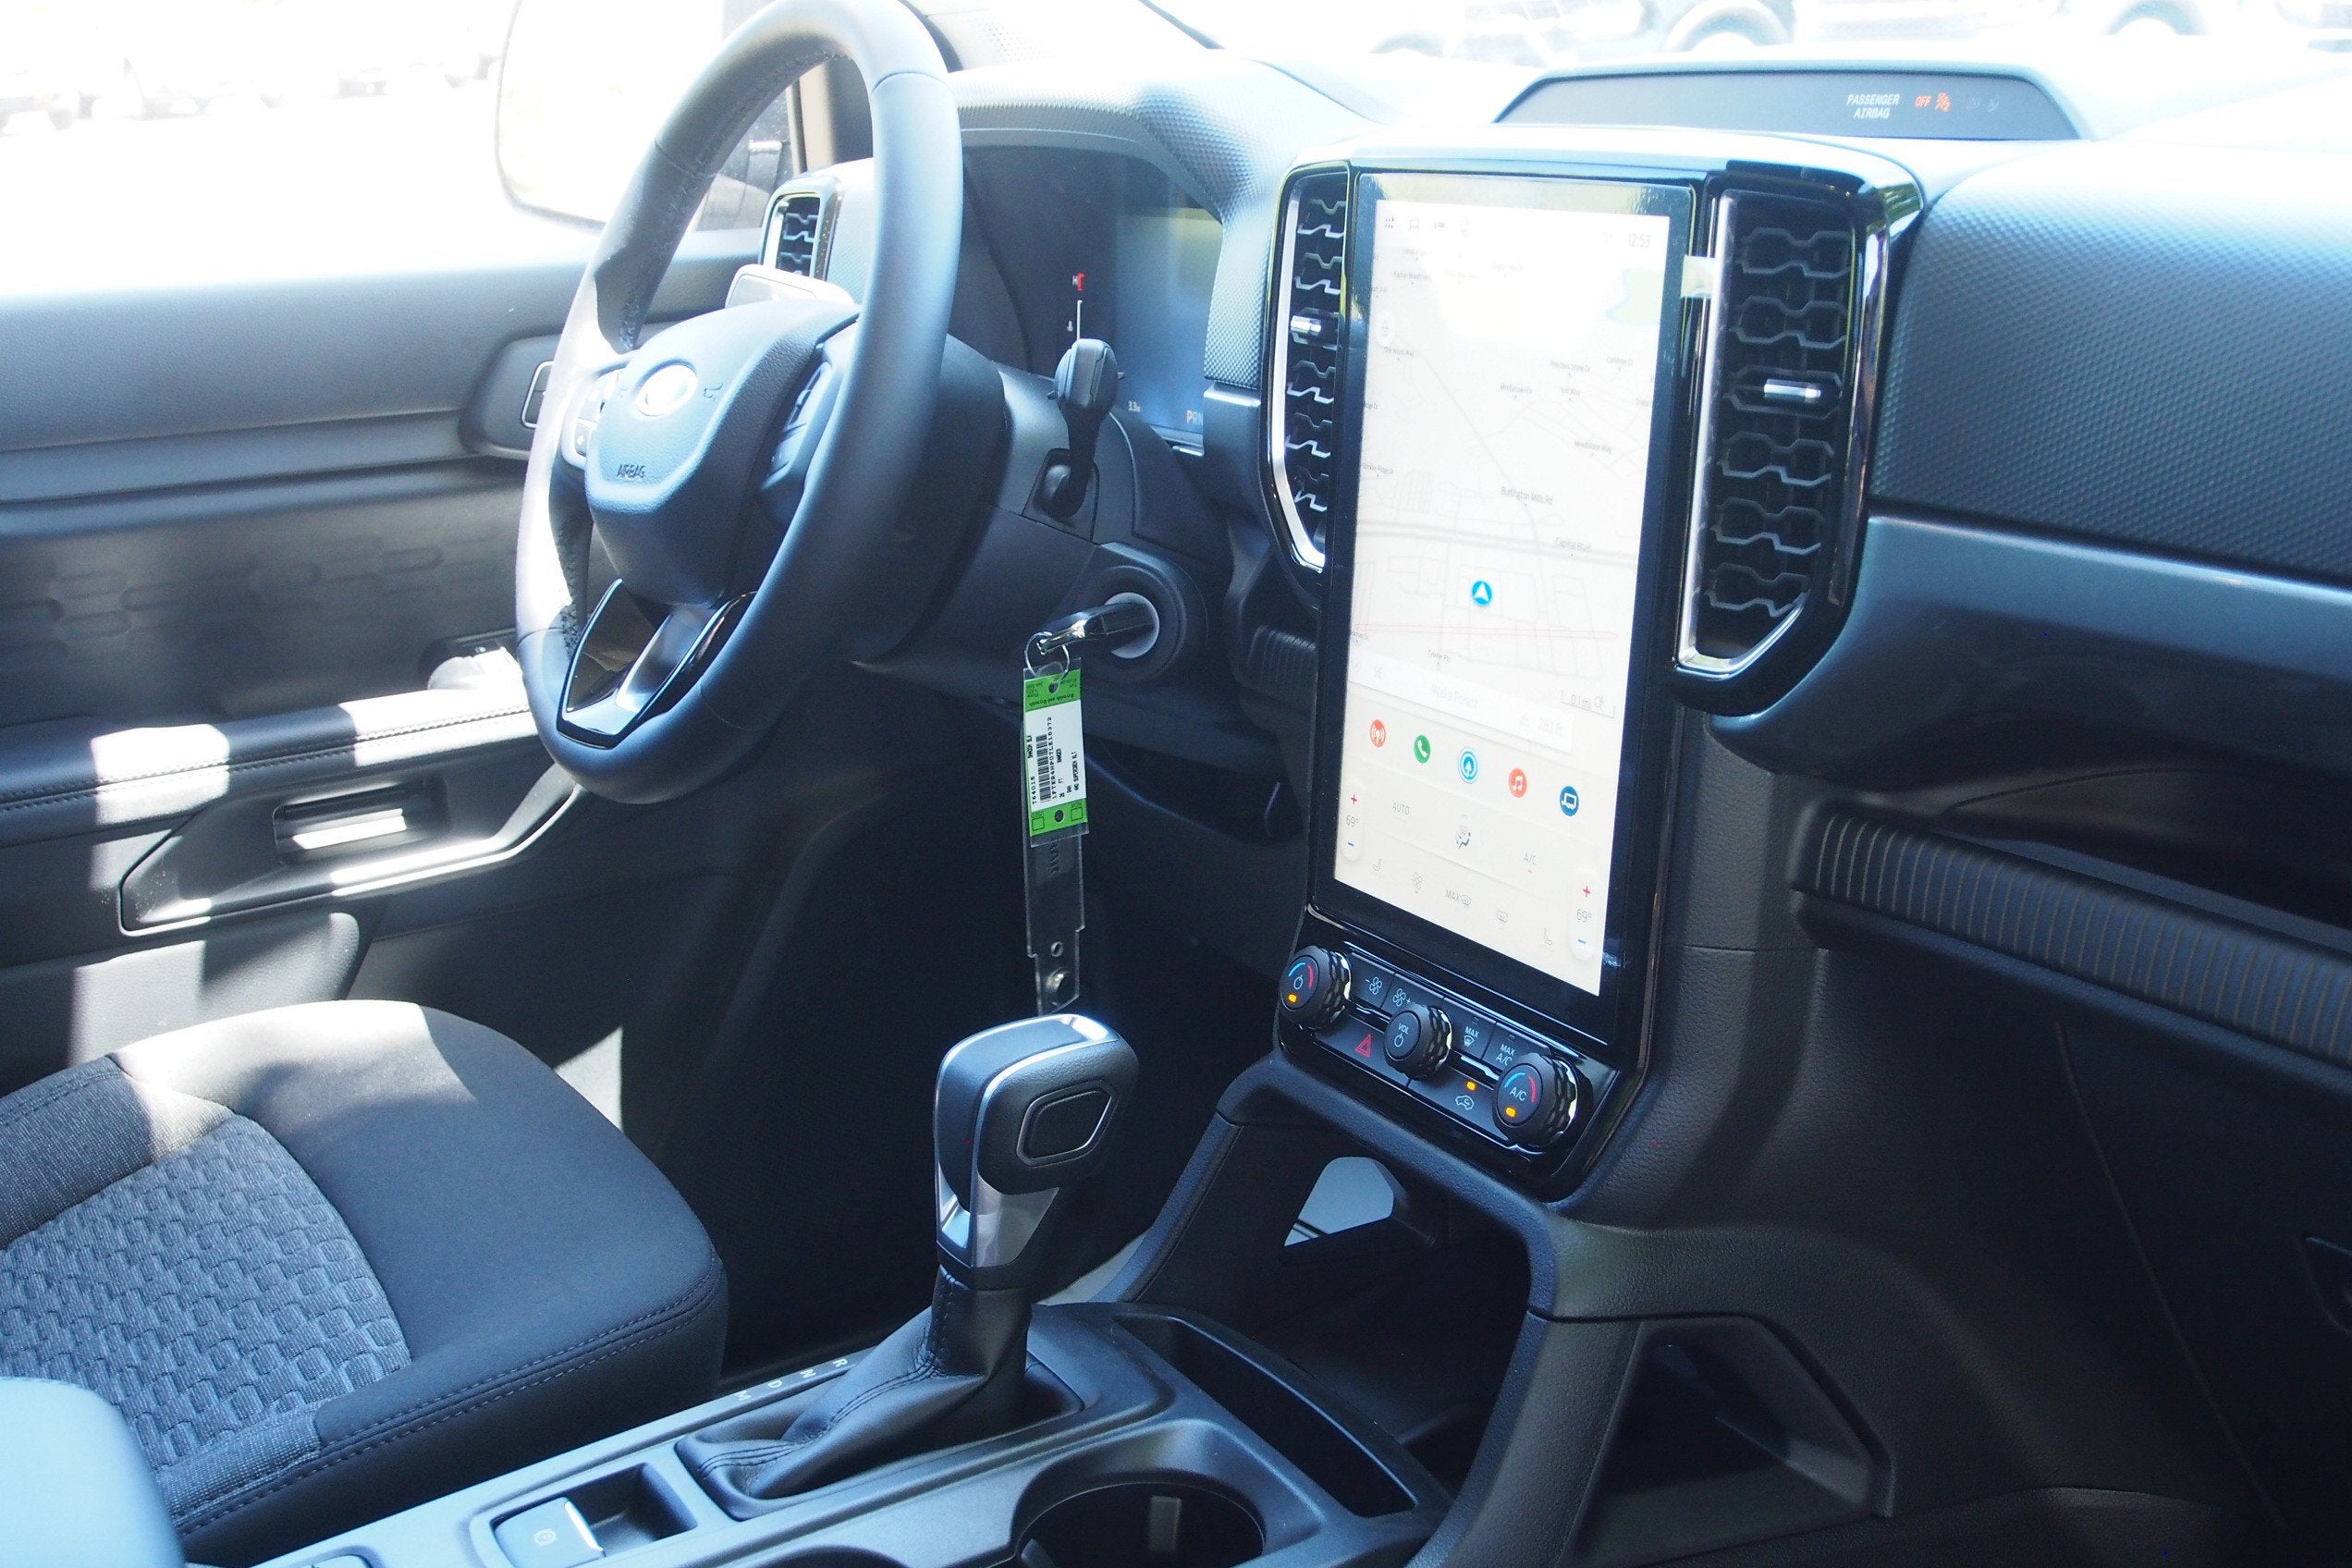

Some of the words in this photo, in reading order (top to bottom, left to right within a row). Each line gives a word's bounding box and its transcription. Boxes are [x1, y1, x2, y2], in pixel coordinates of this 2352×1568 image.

[1846, 92, 1900, 106] PASSENGER
[1915, 95, 1932, 108] OFF
[1853, 107, 1891, 120] AIRBAG
[1628, 232, 1651, 248] 12:53
[617, 463, 645, 479] AIRBAG
[1501, 486, 1530, 501] Burlington
[1531, 492, 1544, 504] Mills
[1545, 495, 1554, 505] Rd
[1555, 536, 1576, 550] Capital
[1576, 542, 1591, 554] Blvd
[1392, 802, 1410, 815] AUTO
[1524, 852, 1537, 865] A/C
[1445, 888, 1460, 902] MAX
[1398, 1023, 1409, 1035] VOL
[1464, 1025, 1479, 1039] MAX
[1500, 1043, 1516, 1056] MAX
[1495, 1054, 1513, 1066] A/C
[1510, 1086, 1527, 1101] A/C
[832, 1358, 848, 1367] R
[801, 1368, 816, 1378] N
[767, 1379, 783, 1389] D
[734, 1390, 753, 1402] M
